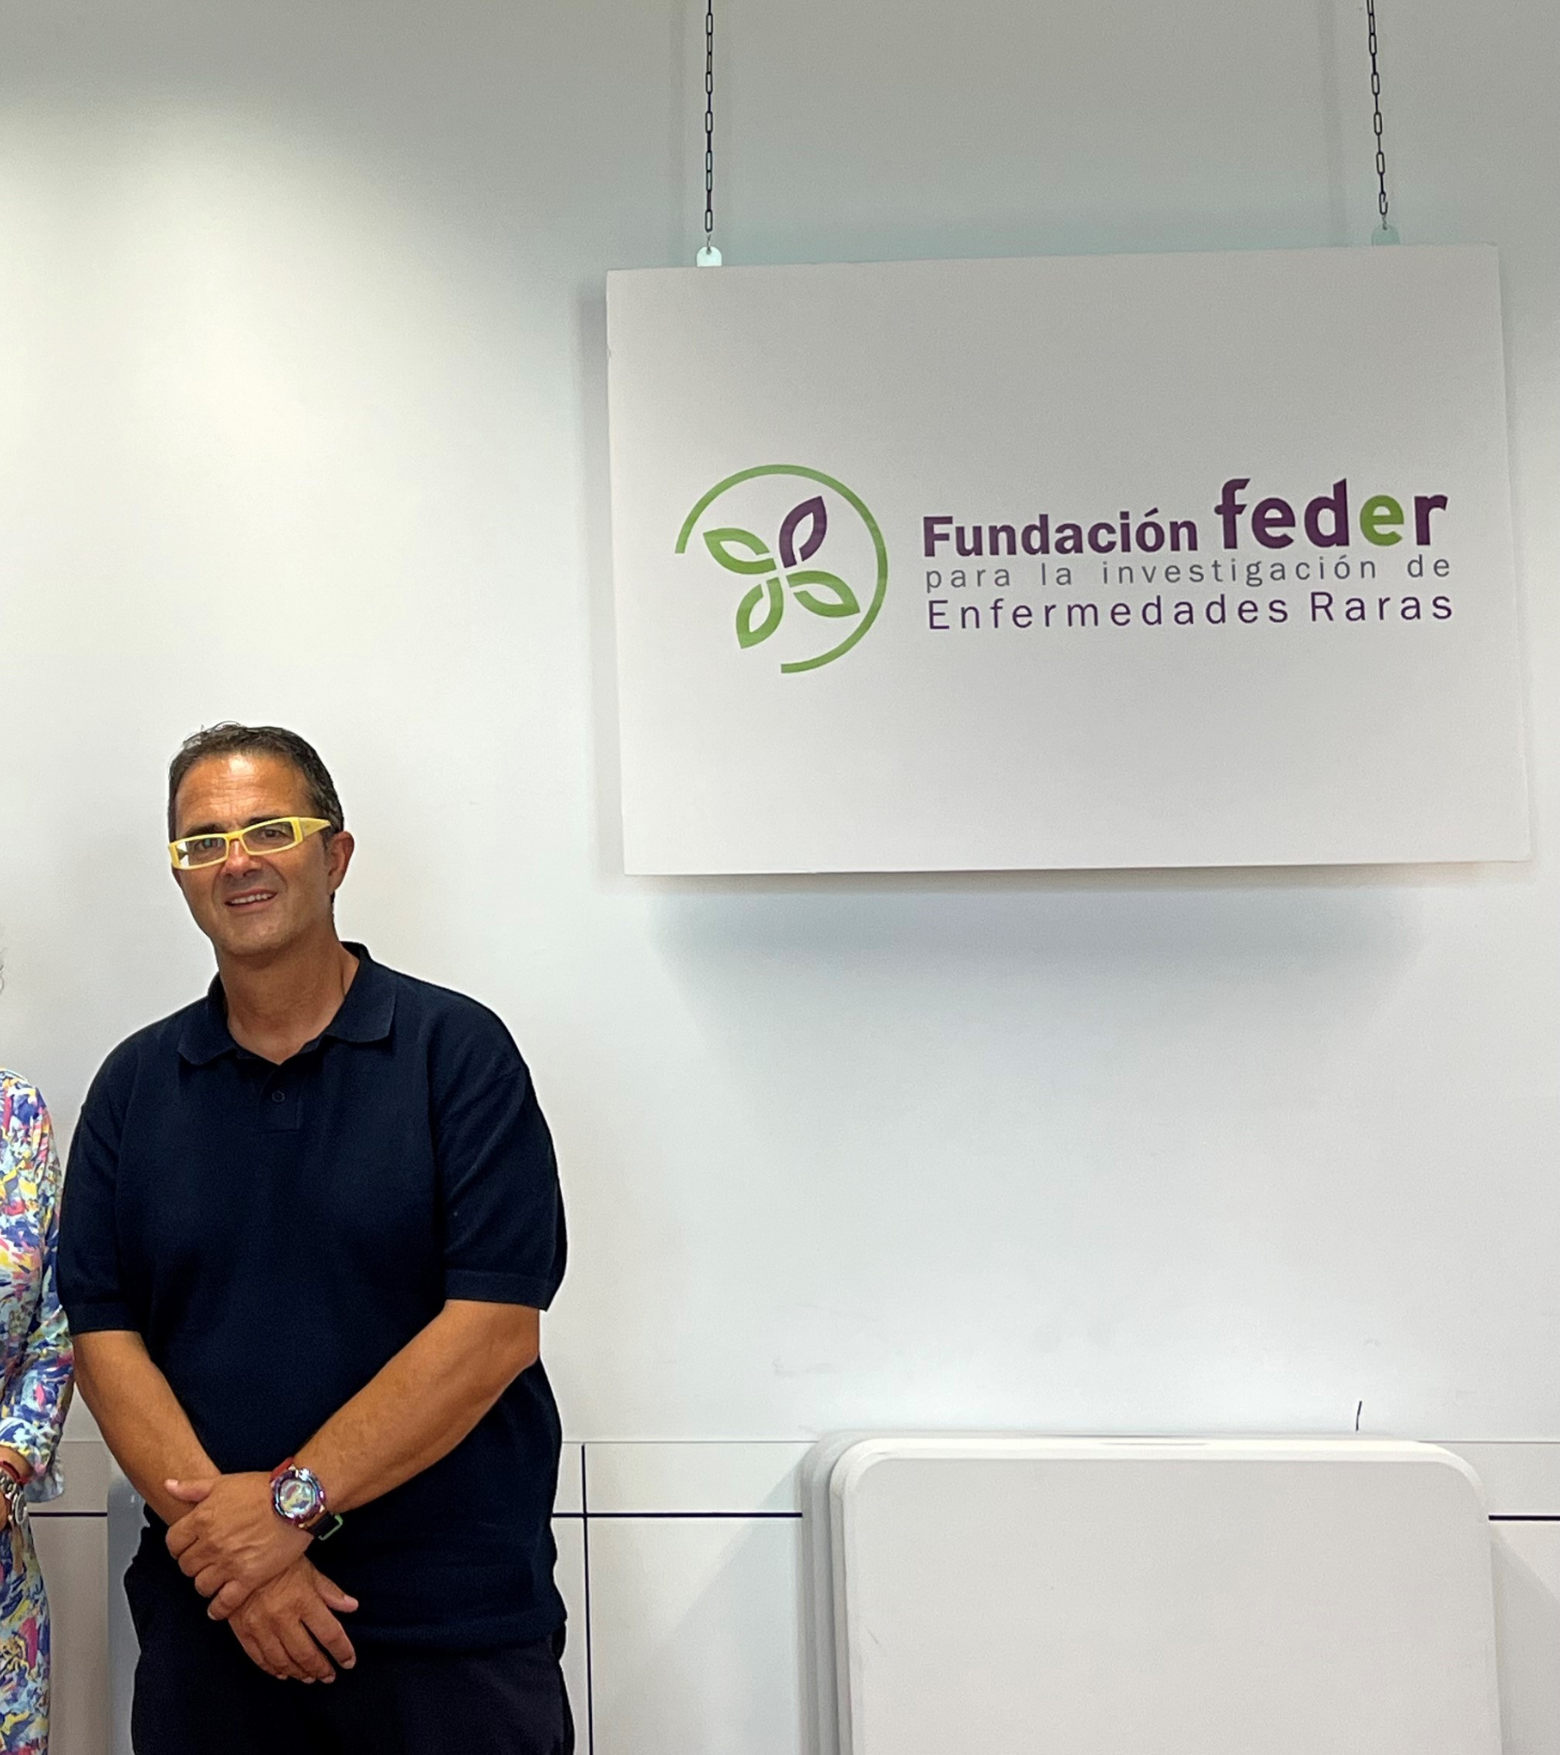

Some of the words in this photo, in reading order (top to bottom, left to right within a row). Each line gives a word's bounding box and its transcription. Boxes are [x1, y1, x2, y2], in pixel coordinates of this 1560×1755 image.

[922, 506, 1199, 558] Fundación
[1213, 478, 1449, 550] feder
[925, 562, 1012, 593] para
[1040, 562, 1073, 587] la
[1101, 554, 1378, 588] investigación
[1406, 554, 1452, 579] de
[927, 594, 1289, 631] Enfermedades
[1309, 591, 1454, 622] Raras
